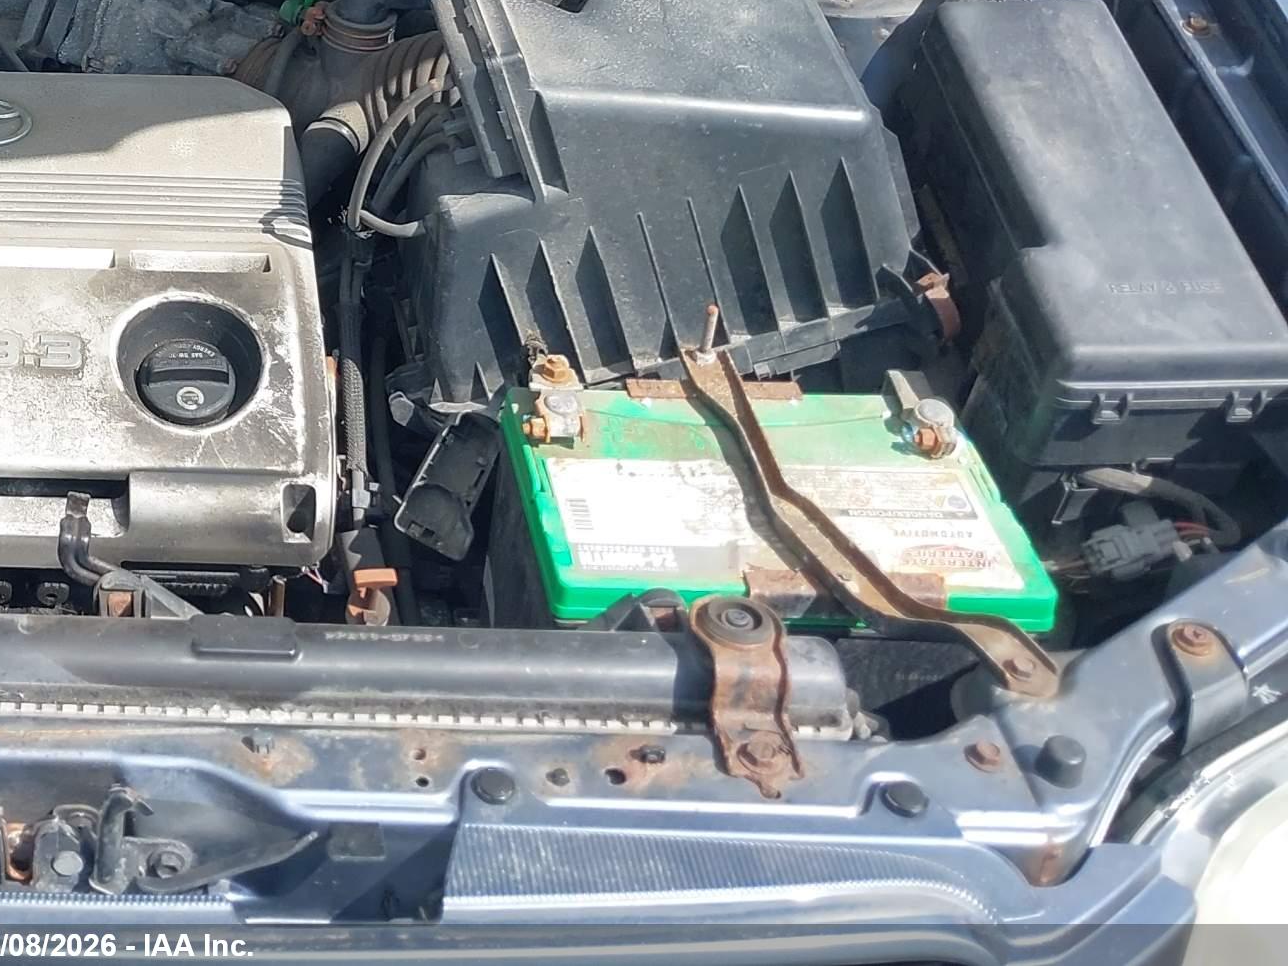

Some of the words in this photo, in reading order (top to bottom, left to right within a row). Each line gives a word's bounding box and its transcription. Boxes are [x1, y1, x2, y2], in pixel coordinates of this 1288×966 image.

[1106, 281, 1156, 294] RELAY
[1181, 281, 1225, 294] FUSE
[892, 529, 974, 540] AUTOMOTIVE
[905, 550, 985, 560] BATTERIES
[902, 558, 992, 569] INTERSTATE
